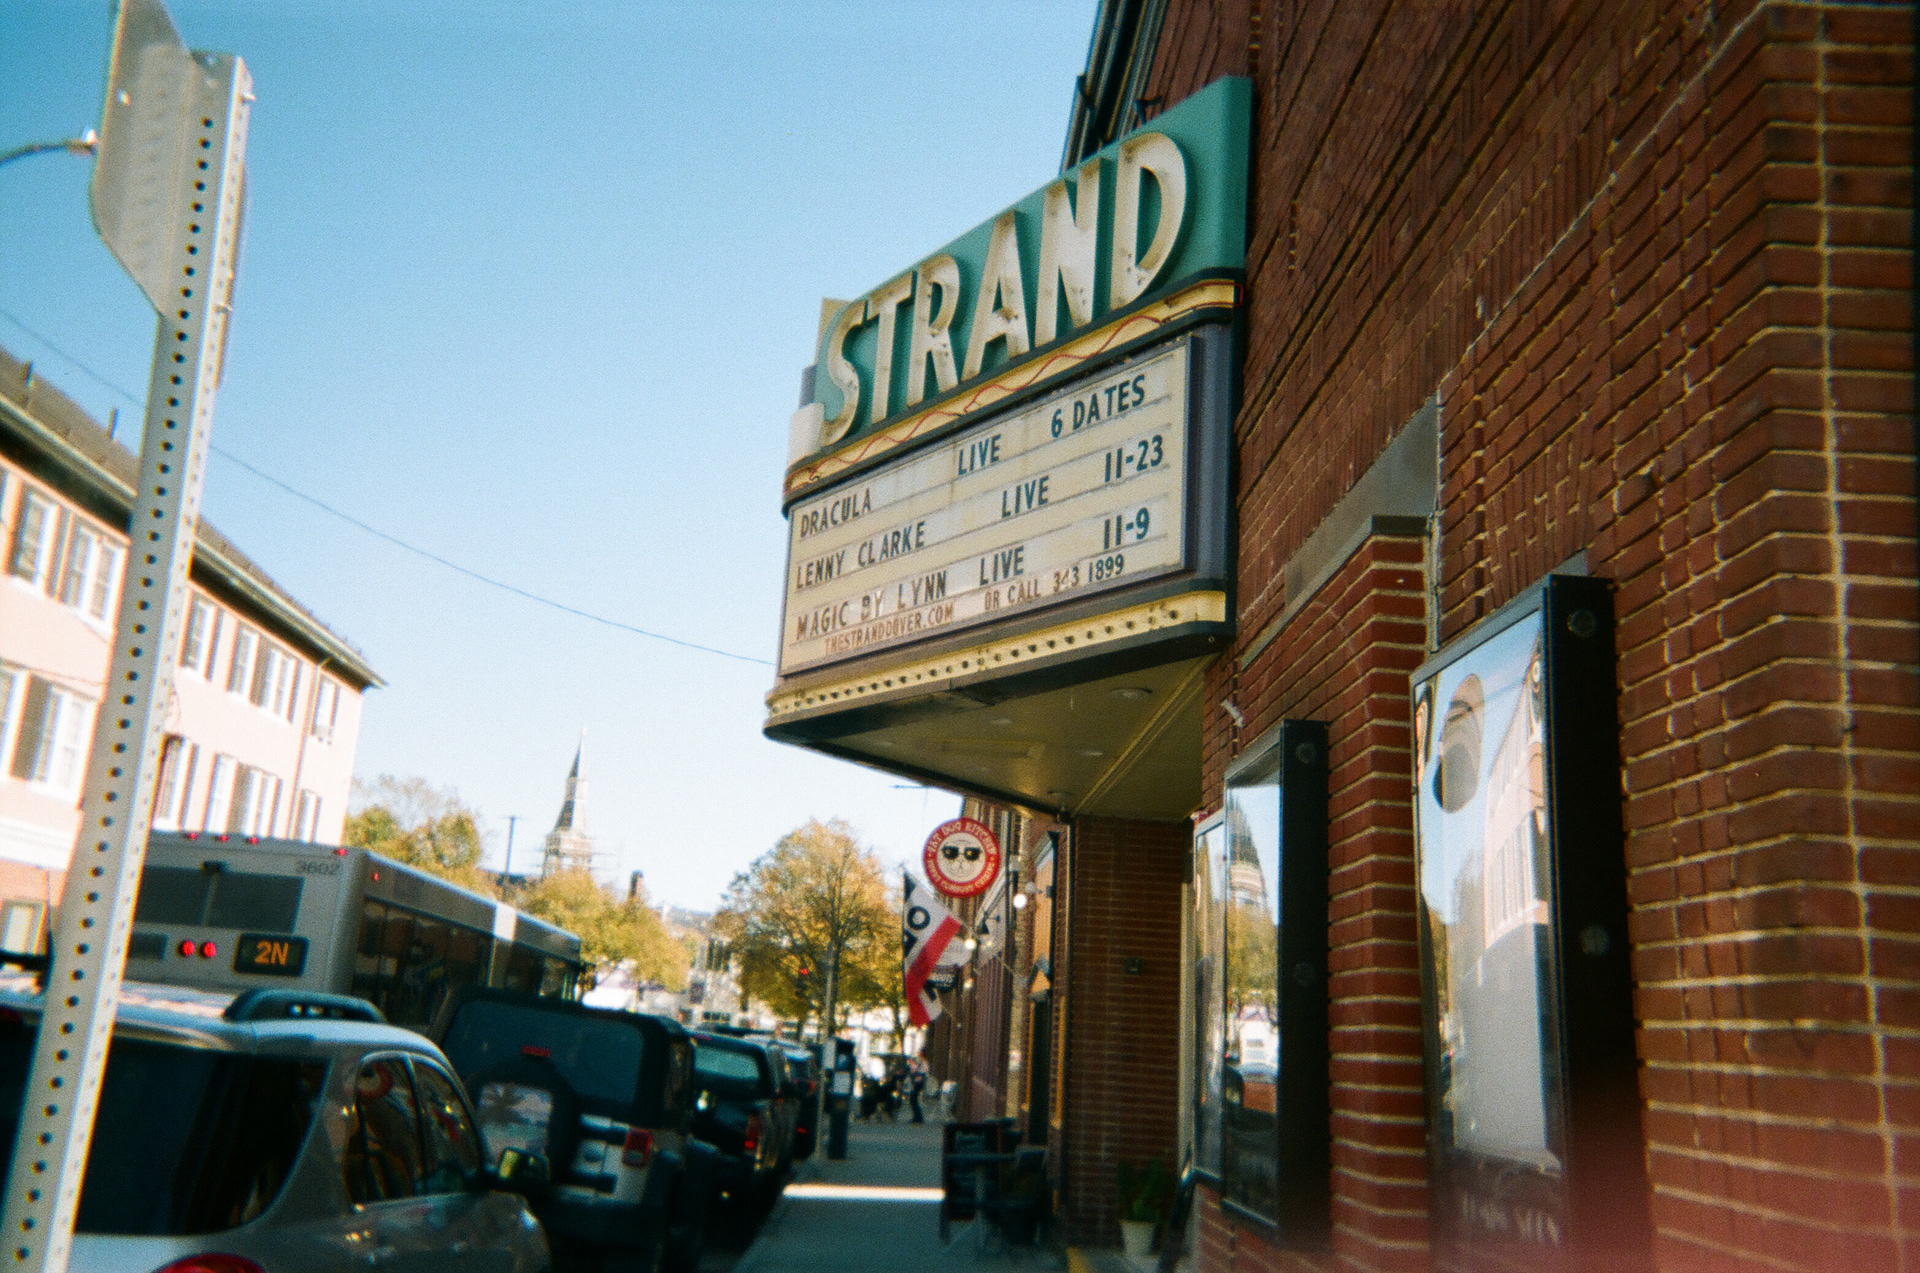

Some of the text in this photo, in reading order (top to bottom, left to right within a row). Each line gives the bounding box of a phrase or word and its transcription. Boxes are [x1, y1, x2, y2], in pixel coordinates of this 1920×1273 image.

[821, 132, 1187, 447] STRAND
[796, 434, 1163, 589] LENNY CLARKE LIVE 11-23
[800, 374, 1145, 538] DRACULA LIVE 6 DATES
[796, 507, 1150, 641] MAGIC BY LYNN LIVE 11-9
[824, 602, 955, 655] THESTRANDDOVER.COM
[984, 589, 999, 610] OR
[1007, 578, 1041, 604] CALL
[1088, 553, 1124, 582] 1899
[940, 821, 962, 836] DOG
[254, 940, 289, 965] 2N
